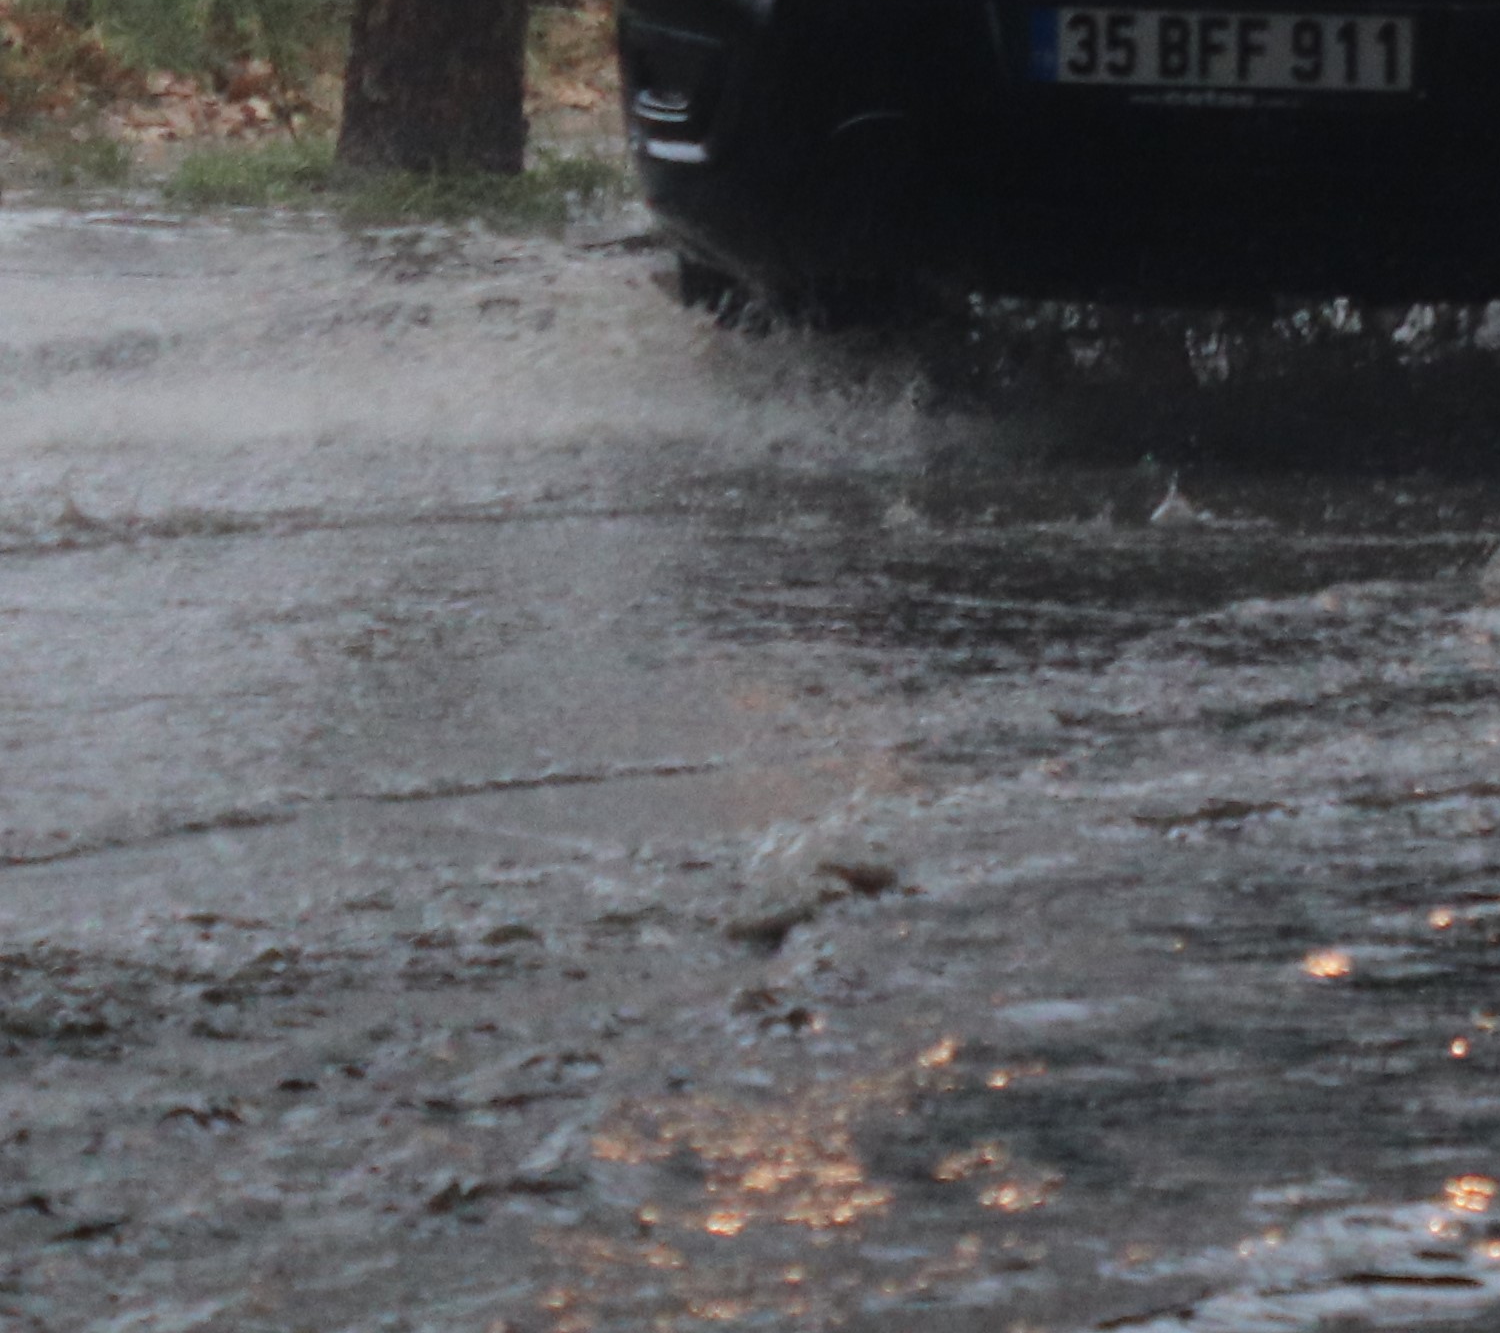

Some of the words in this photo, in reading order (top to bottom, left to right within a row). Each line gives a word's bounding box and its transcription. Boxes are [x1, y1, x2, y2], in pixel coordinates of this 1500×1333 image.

[1066, 13, 1137, 78] 35
[1157, 16, 1269, 81] BFF
[1291, 19, 1399, 84] 911
